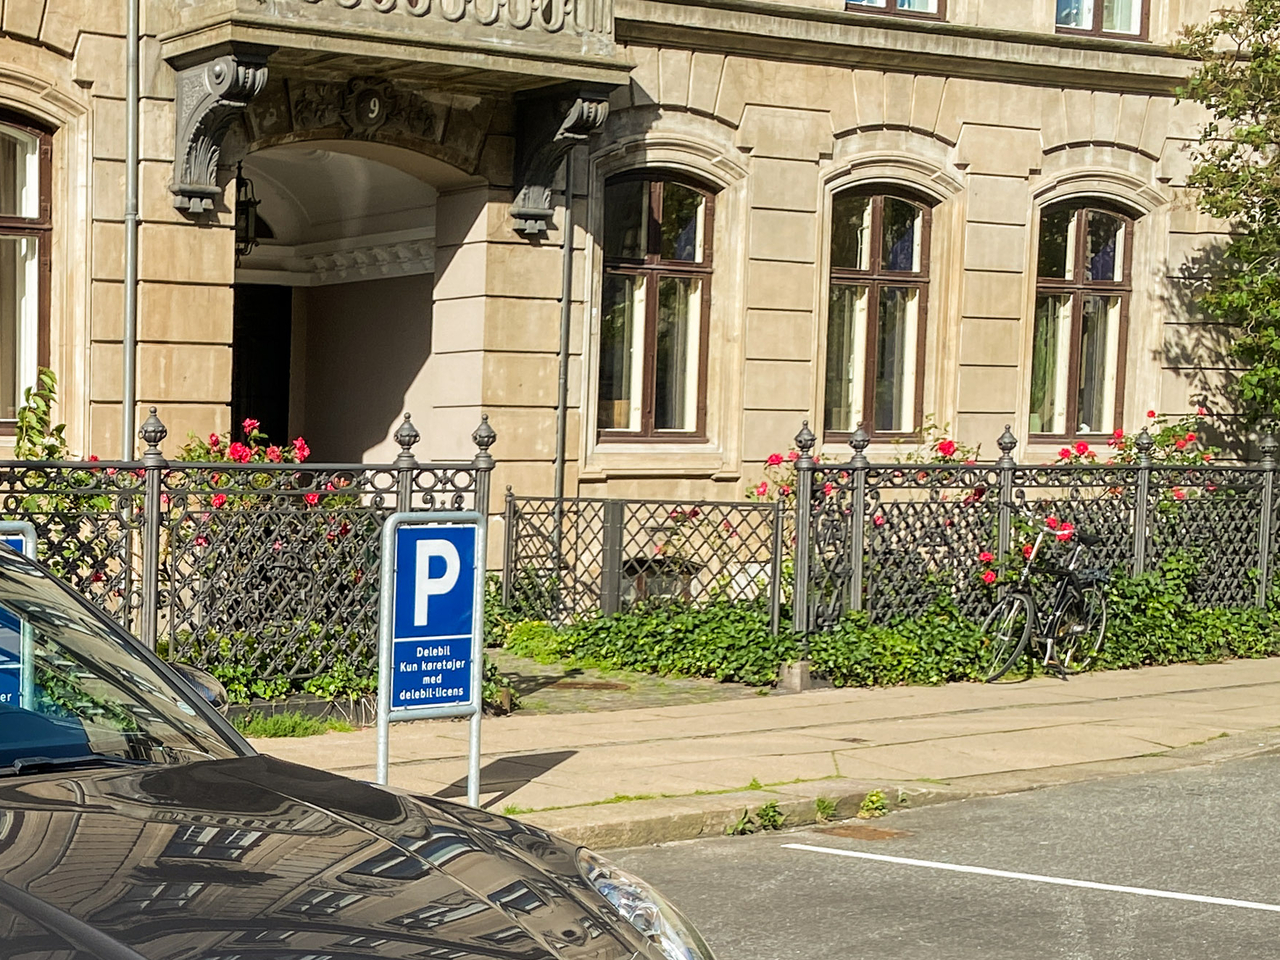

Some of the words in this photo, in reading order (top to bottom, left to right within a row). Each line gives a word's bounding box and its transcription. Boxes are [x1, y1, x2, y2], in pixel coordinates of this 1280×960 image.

[368, 97, 380, 119] 9
[414, 539, 461, 626] P
[416, 645, 450, 657] Delebil
[400, 661, 418, 672] Kun
[421, 658, 465, 671] køretøjer
[422, 673, 442, 684] med
